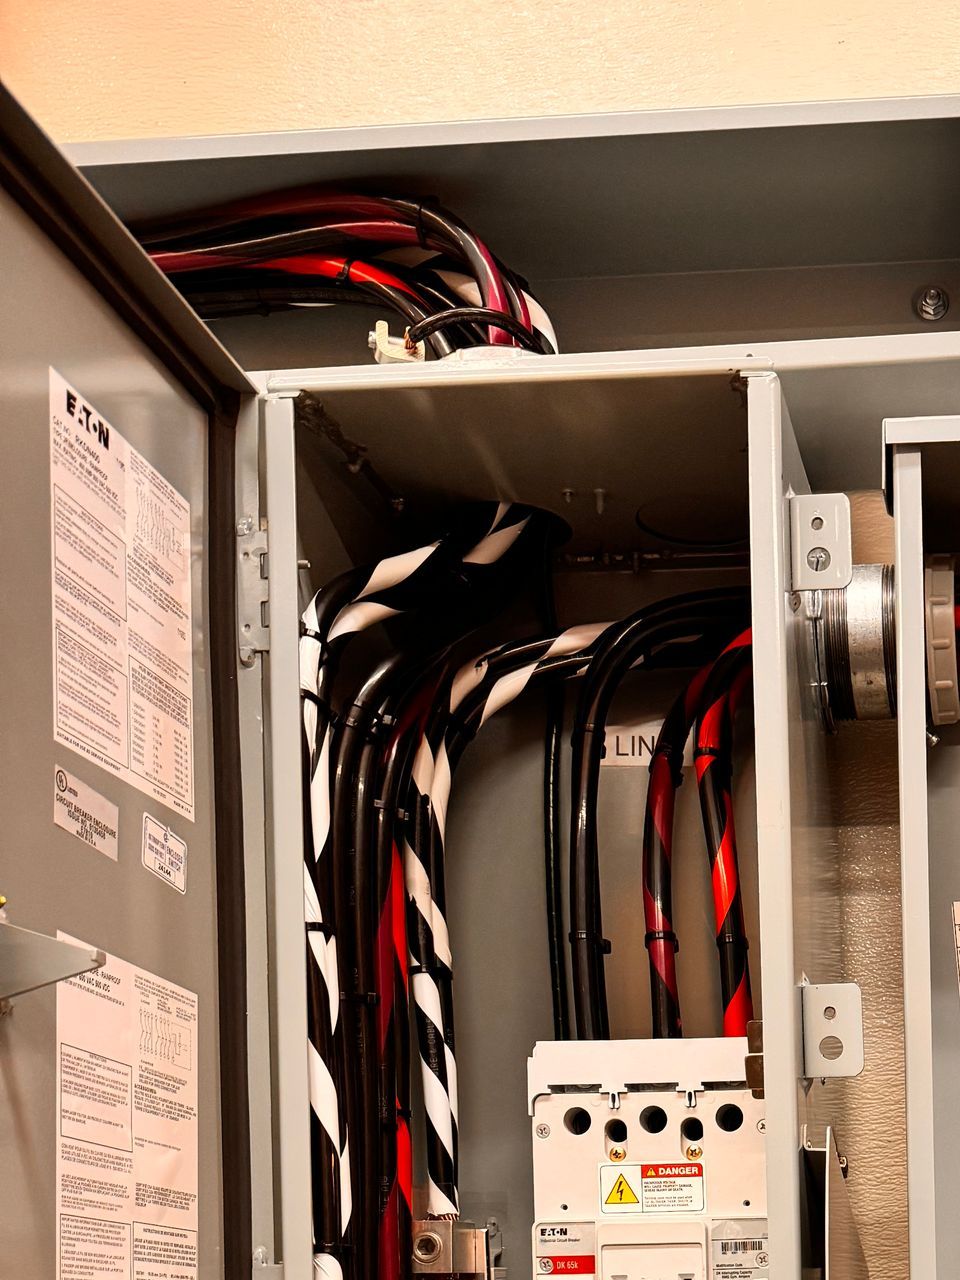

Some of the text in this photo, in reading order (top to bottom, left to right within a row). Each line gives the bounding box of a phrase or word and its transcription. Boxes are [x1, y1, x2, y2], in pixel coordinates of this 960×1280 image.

[615, 735, 655, 757] LIN
[56, 792, 117, 840] CIRCUIT BREAKER ENCLOSURE
[658, 1166, 699, 1175] DANGER
[540, 1228, 568, 1236] EATON
[556, 1260, 579, 1269] DK 65k
